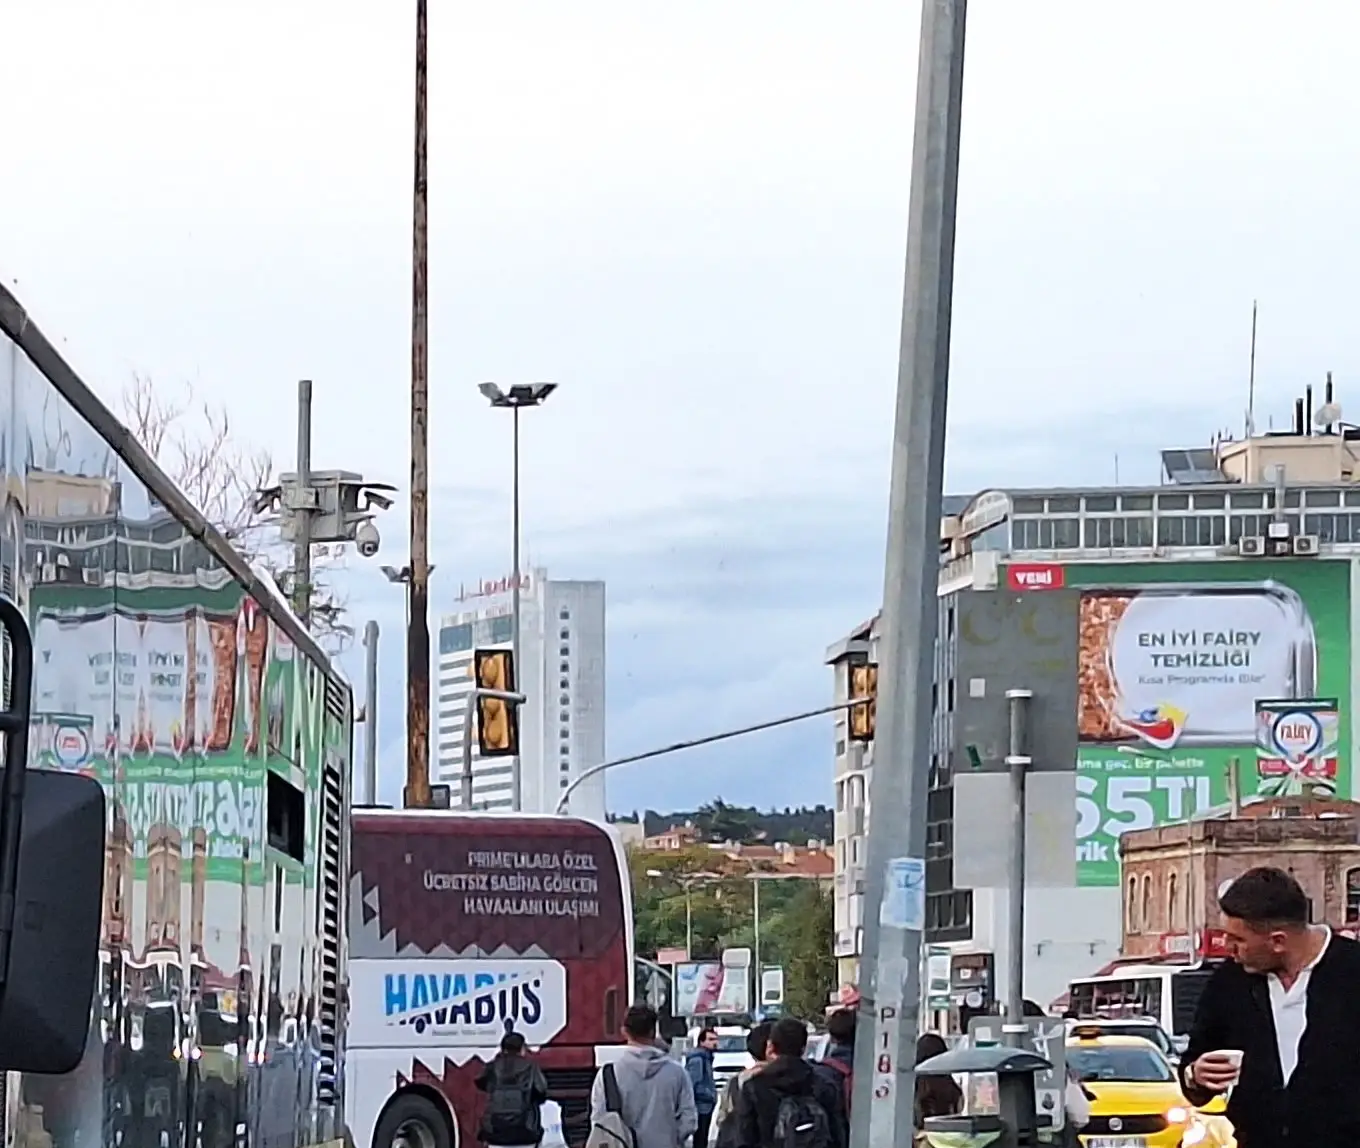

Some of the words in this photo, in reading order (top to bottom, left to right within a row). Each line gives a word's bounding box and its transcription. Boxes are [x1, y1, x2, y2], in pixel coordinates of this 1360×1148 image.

[1138, 632, 1165, 647] EN
[1172, 629, 1197, 646] İYİ
[1203, 629, 1262, 647] FAİRY
[1150, 649, 1250, 668] TEMİZLİĞİ
